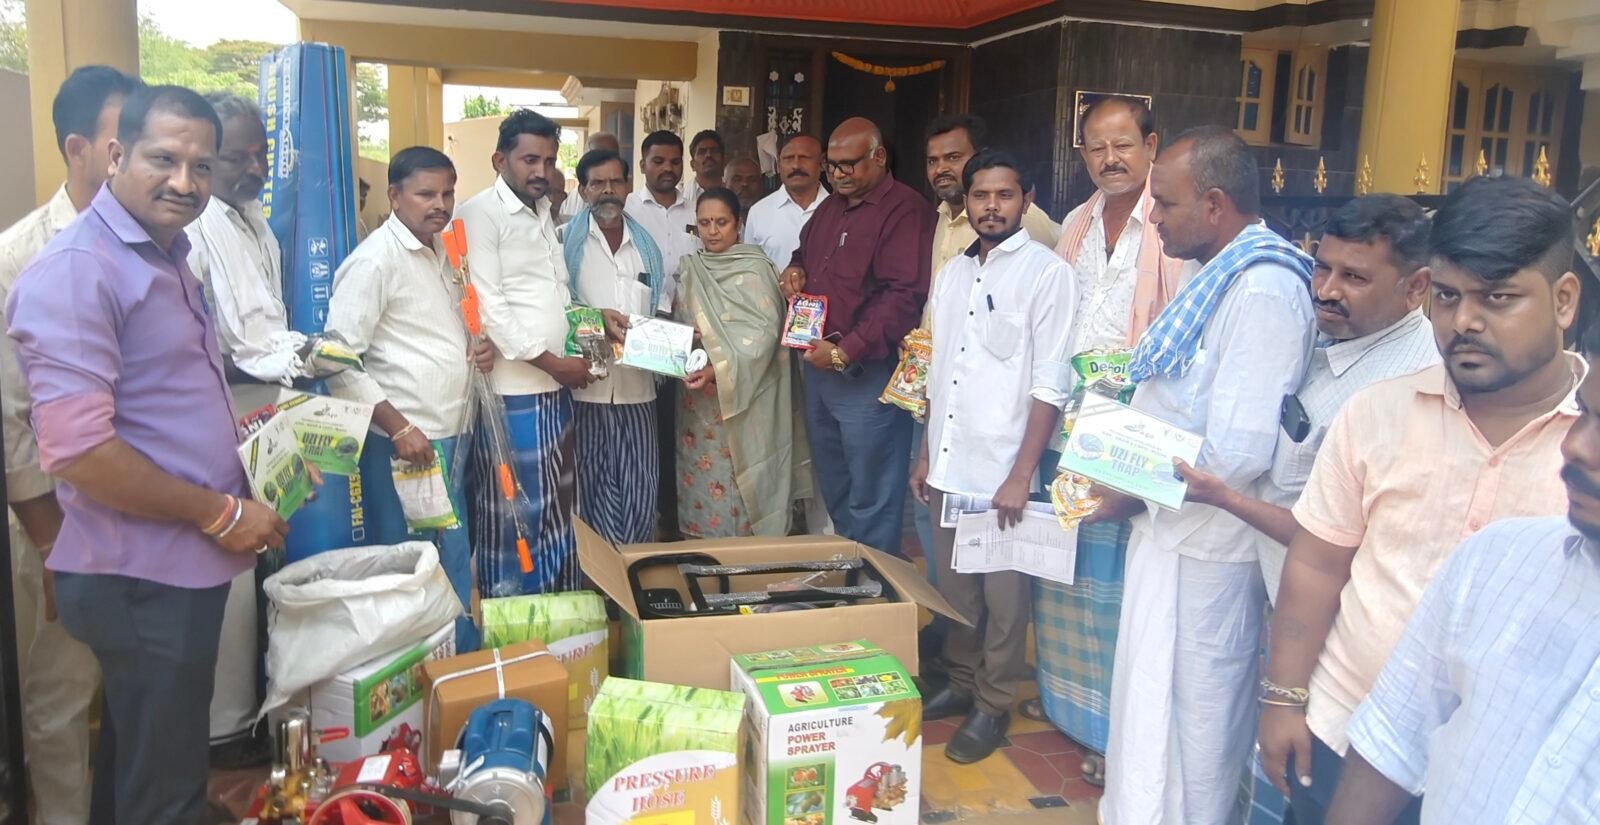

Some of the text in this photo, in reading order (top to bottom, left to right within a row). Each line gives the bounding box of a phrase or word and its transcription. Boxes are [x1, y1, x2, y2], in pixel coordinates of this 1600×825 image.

[266, 63, 277, 132] BRUSH
[1110, 445, 1150, 467] UZI FLY
[1111, 460, 1141, 477] TRAP
[788, 717, 853, 732] AGRICULTURE
[787, 732, 826, 745] POWER
[787, 742, 836, 756] SPRAYER
[613, 764, 717, 792] PRESSURE
[631, 790, 687, 812] HOSE
